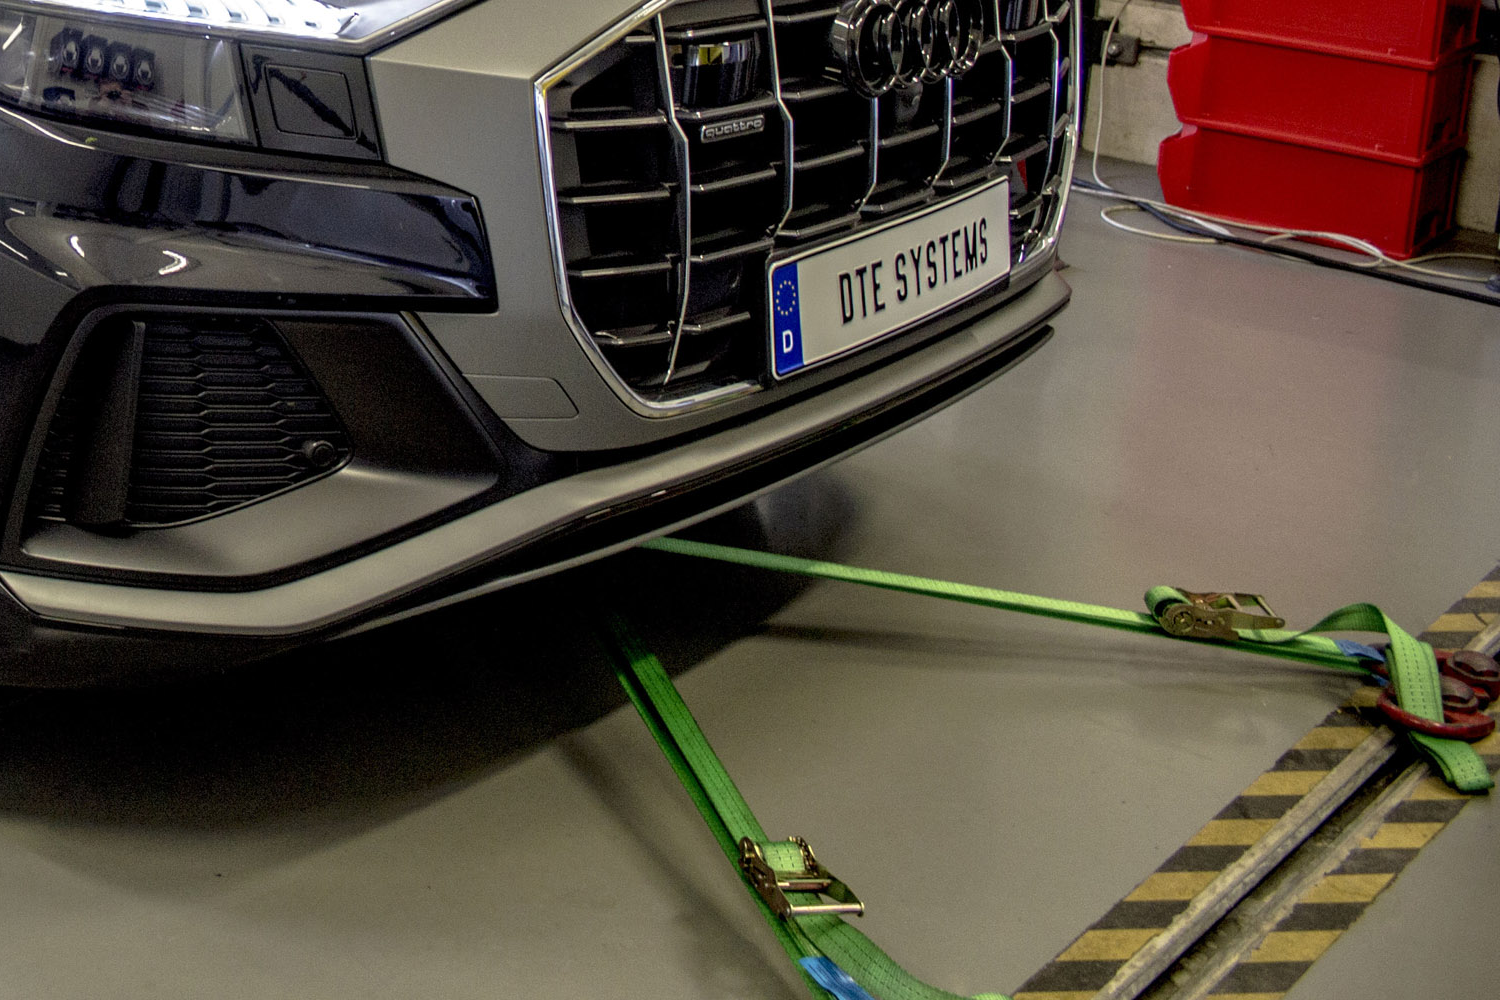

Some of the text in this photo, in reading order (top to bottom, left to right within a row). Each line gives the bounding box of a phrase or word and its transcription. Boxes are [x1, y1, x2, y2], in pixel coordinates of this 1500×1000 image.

[705, 119, 762, 138] quattro
[838, 217, 988, 325] DTE SYSTEMS
[782, 330, 794, 354] D
